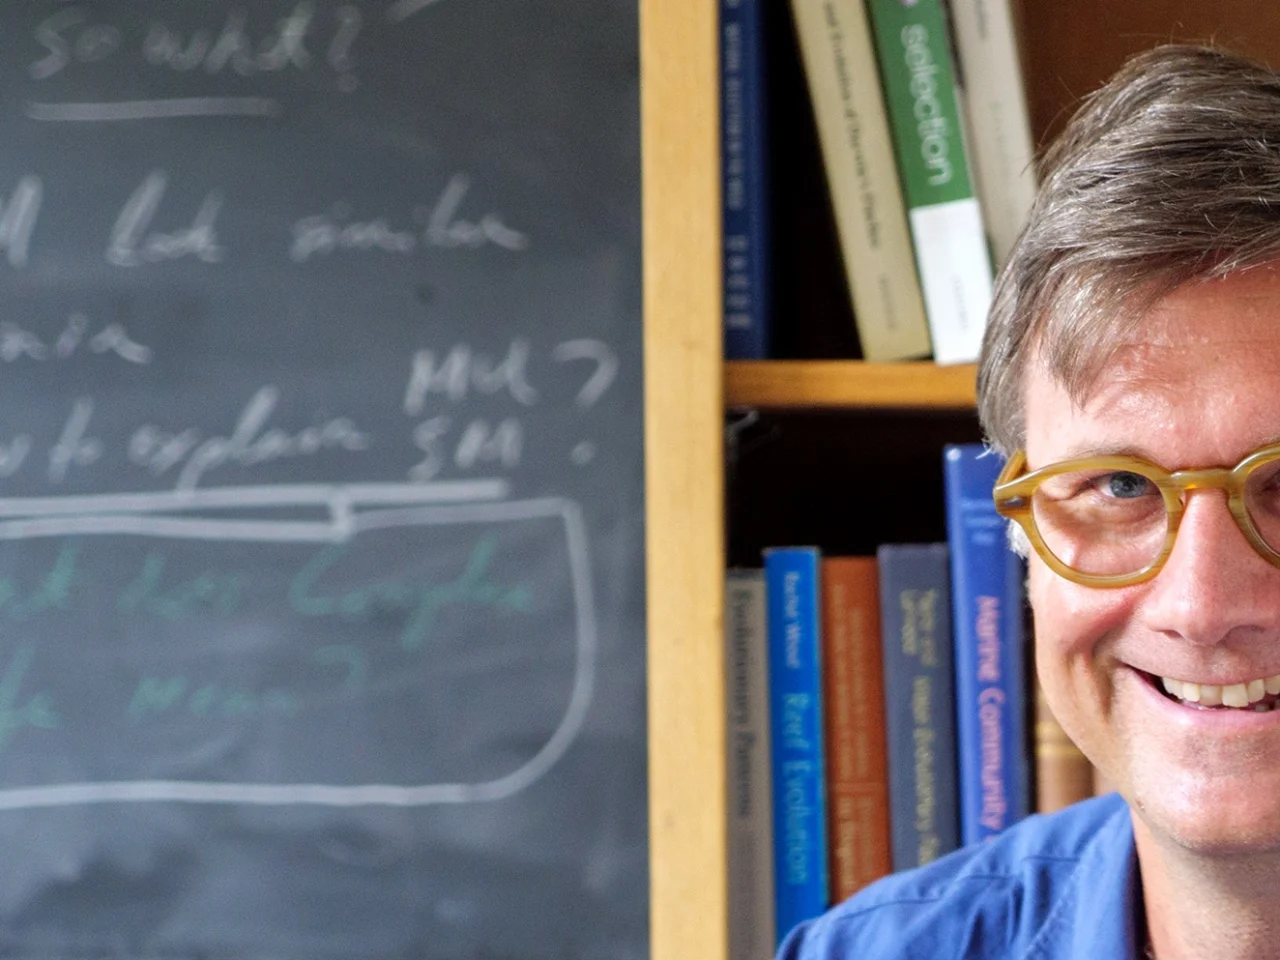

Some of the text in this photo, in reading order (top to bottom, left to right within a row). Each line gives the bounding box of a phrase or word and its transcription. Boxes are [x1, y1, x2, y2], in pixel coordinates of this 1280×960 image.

[901, 22, 953, 187] selection
[782, 693, 811, 748] Reef
[976, 595, 1007, 830] Marine Community
[784, 760, 813, 885] Evolution
